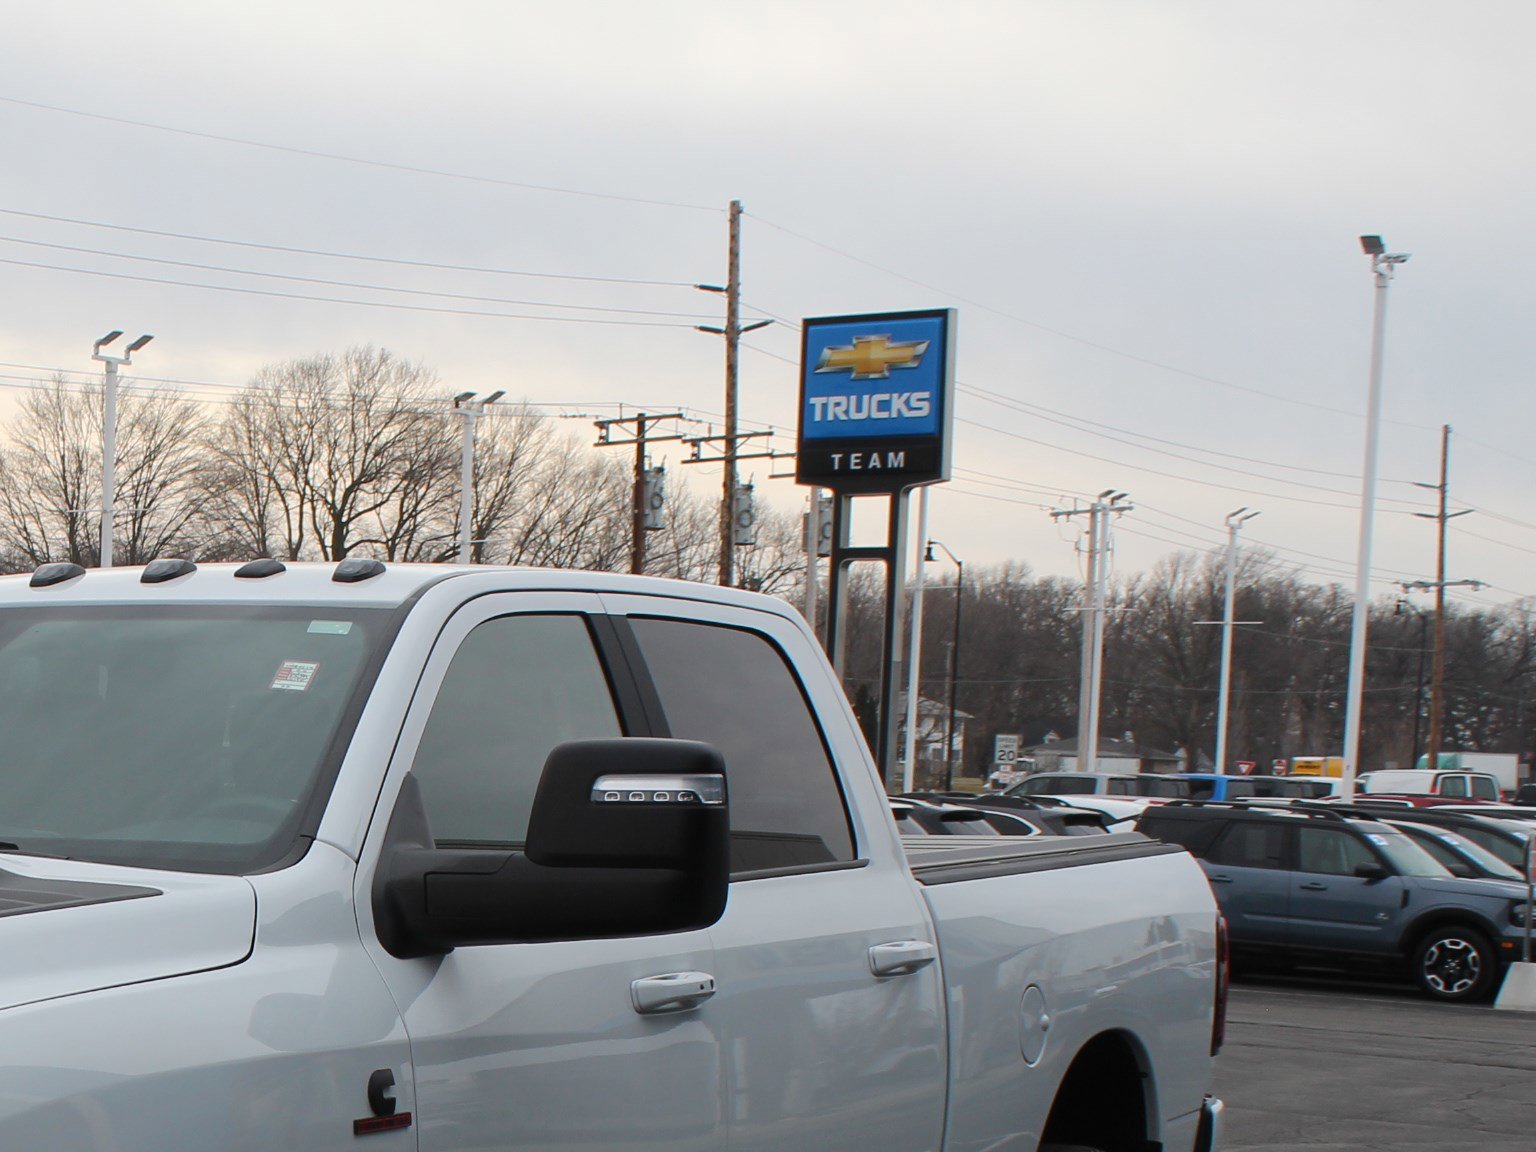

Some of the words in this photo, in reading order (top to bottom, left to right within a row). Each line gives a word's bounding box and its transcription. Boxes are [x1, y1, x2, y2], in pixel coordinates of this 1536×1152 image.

[809, 391, 931, 422] TRUCKS
[831, 451, 906, 470] TEAM
[998, 749, 1015, 761] 20
